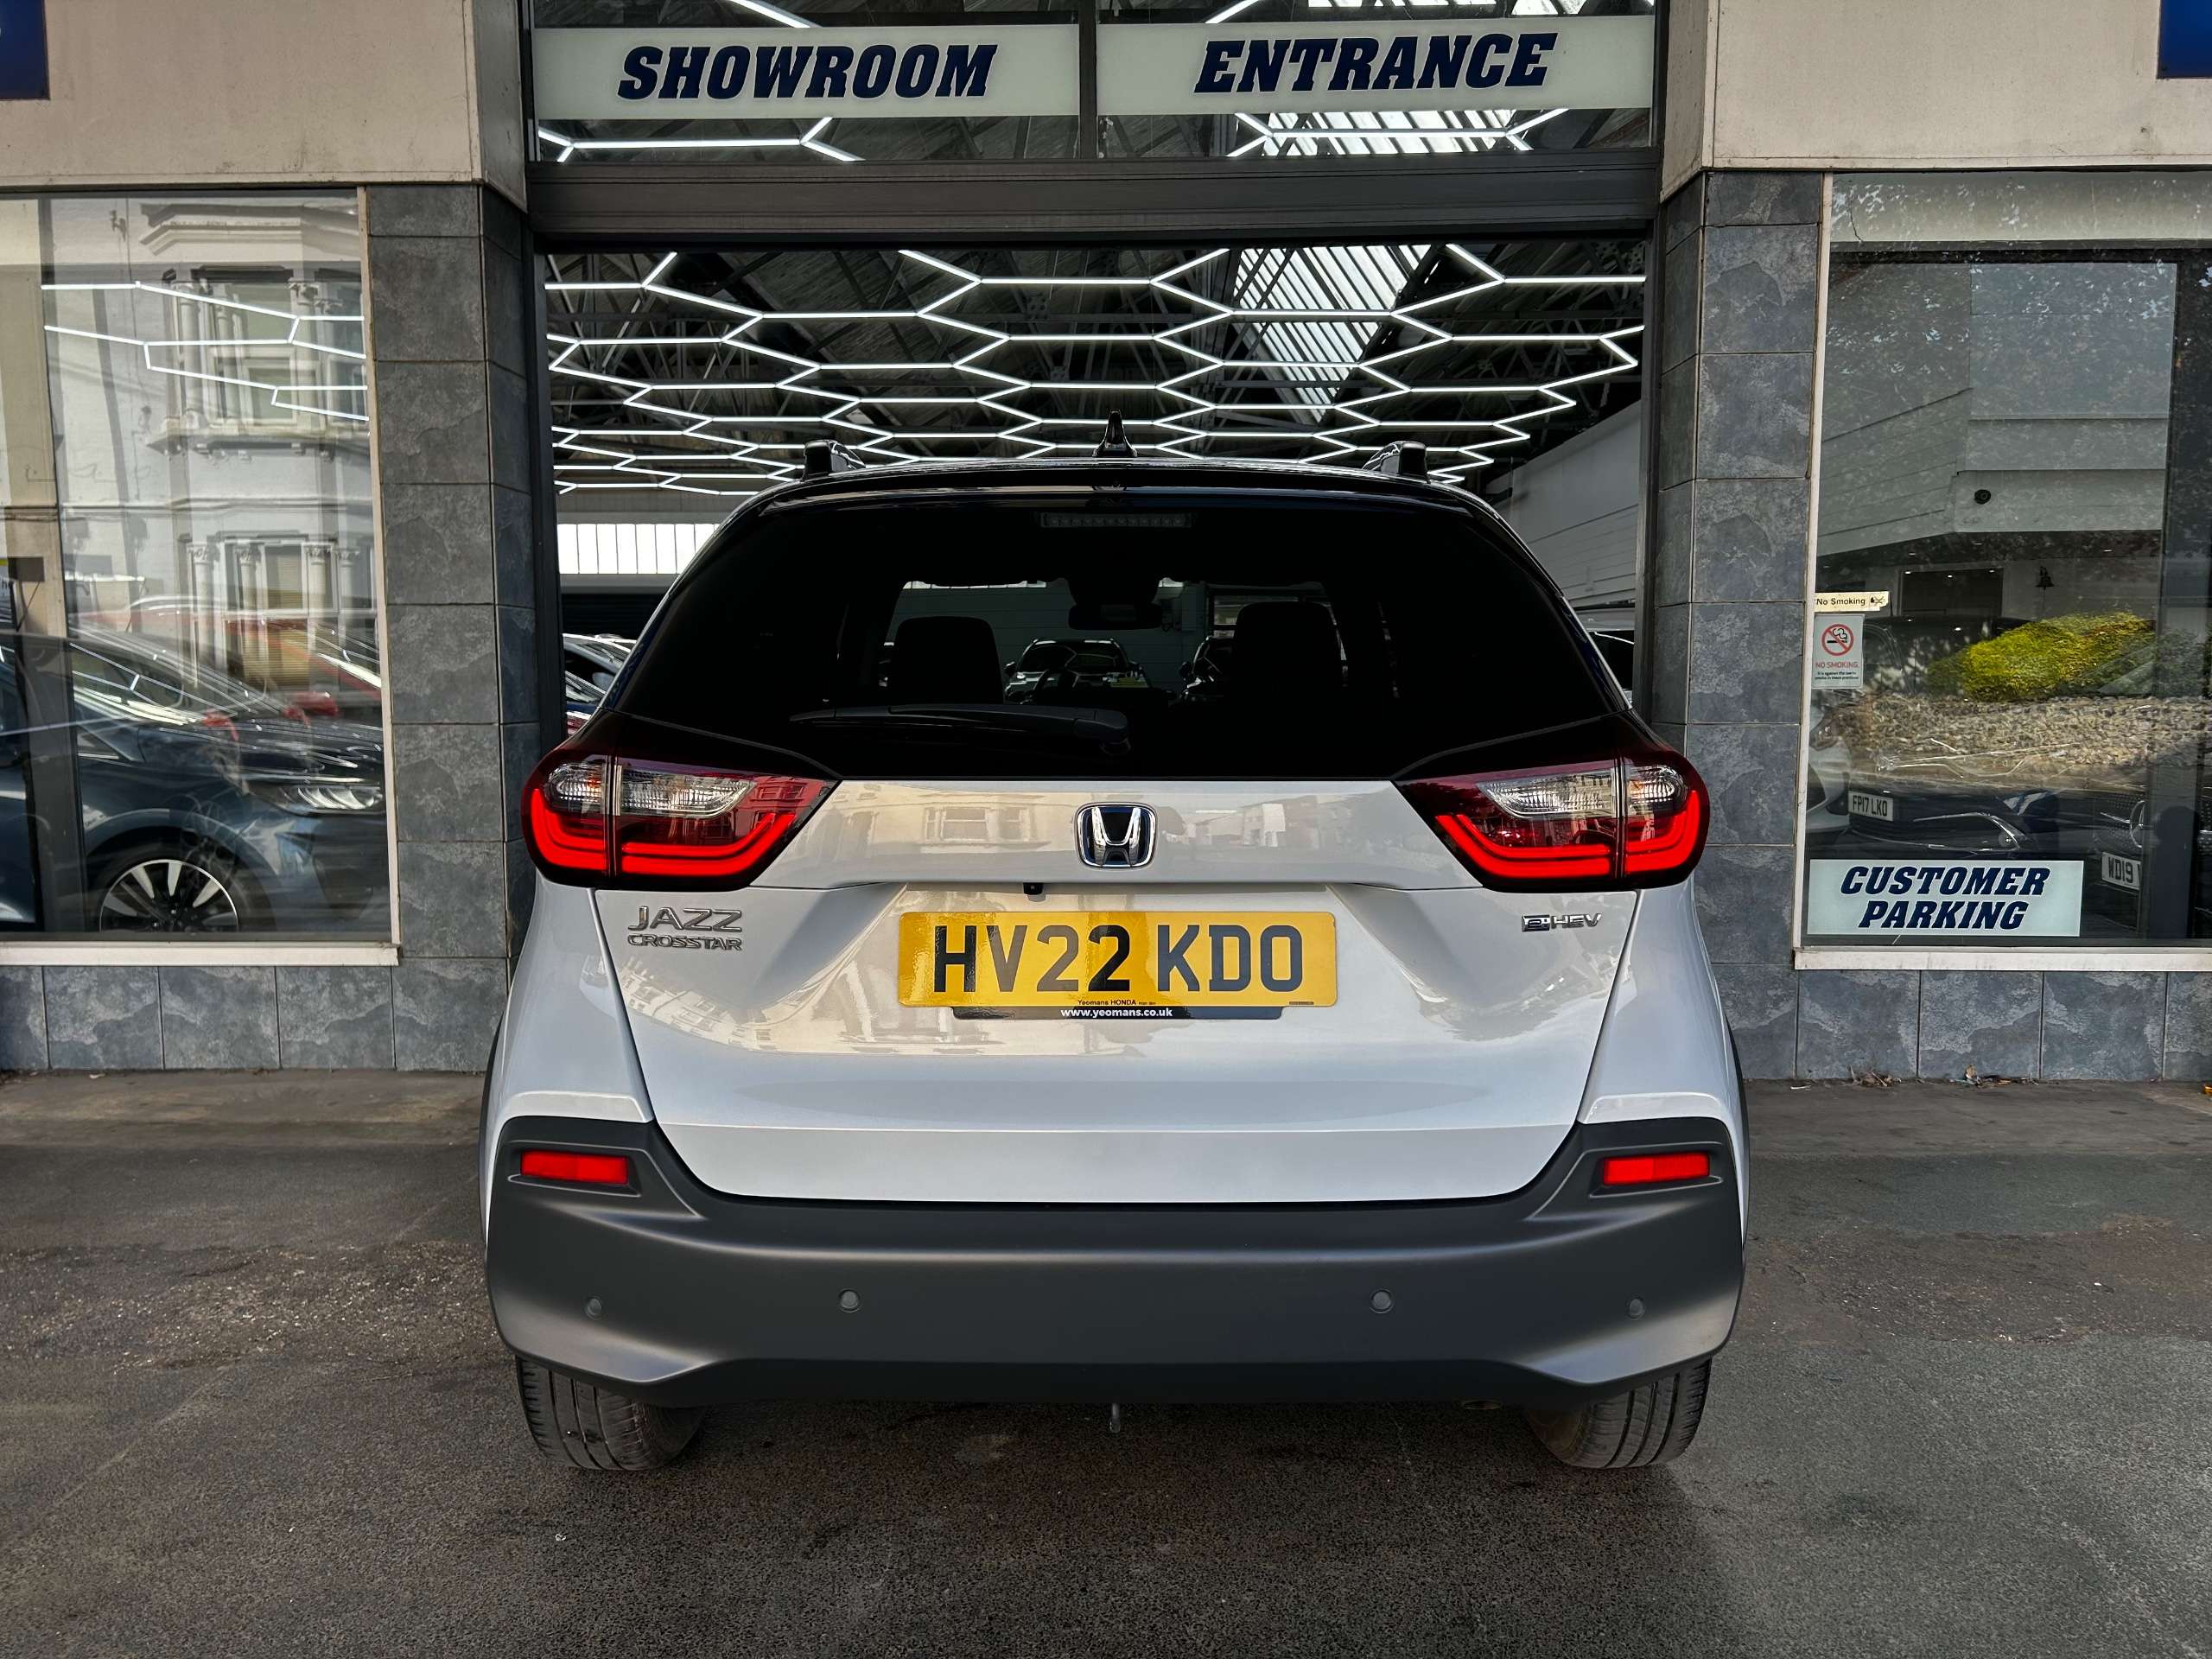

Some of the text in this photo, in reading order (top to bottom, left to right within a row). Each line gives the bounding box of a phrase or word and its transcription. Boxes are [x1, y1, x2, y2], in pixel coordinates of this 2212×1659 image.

[617, 32, 1559, 99] SHOWROOM ENTRANCE
[1831, 597, 1866, 607] Smoking
[1853, 794, 1888, 817] FP17 LKO
[1840, 866, 2051, 896] CUSTOMER
[627, 906, 743, 932] JAZZ
[1858, 900, 2030, 931] PARKING
[627, 933, 743, 951] CROSSTAR
[934, 925, 1303, 993] HV22 KDO
[1060, 1007, 1173, 1019] www.yeomans.co.uk
